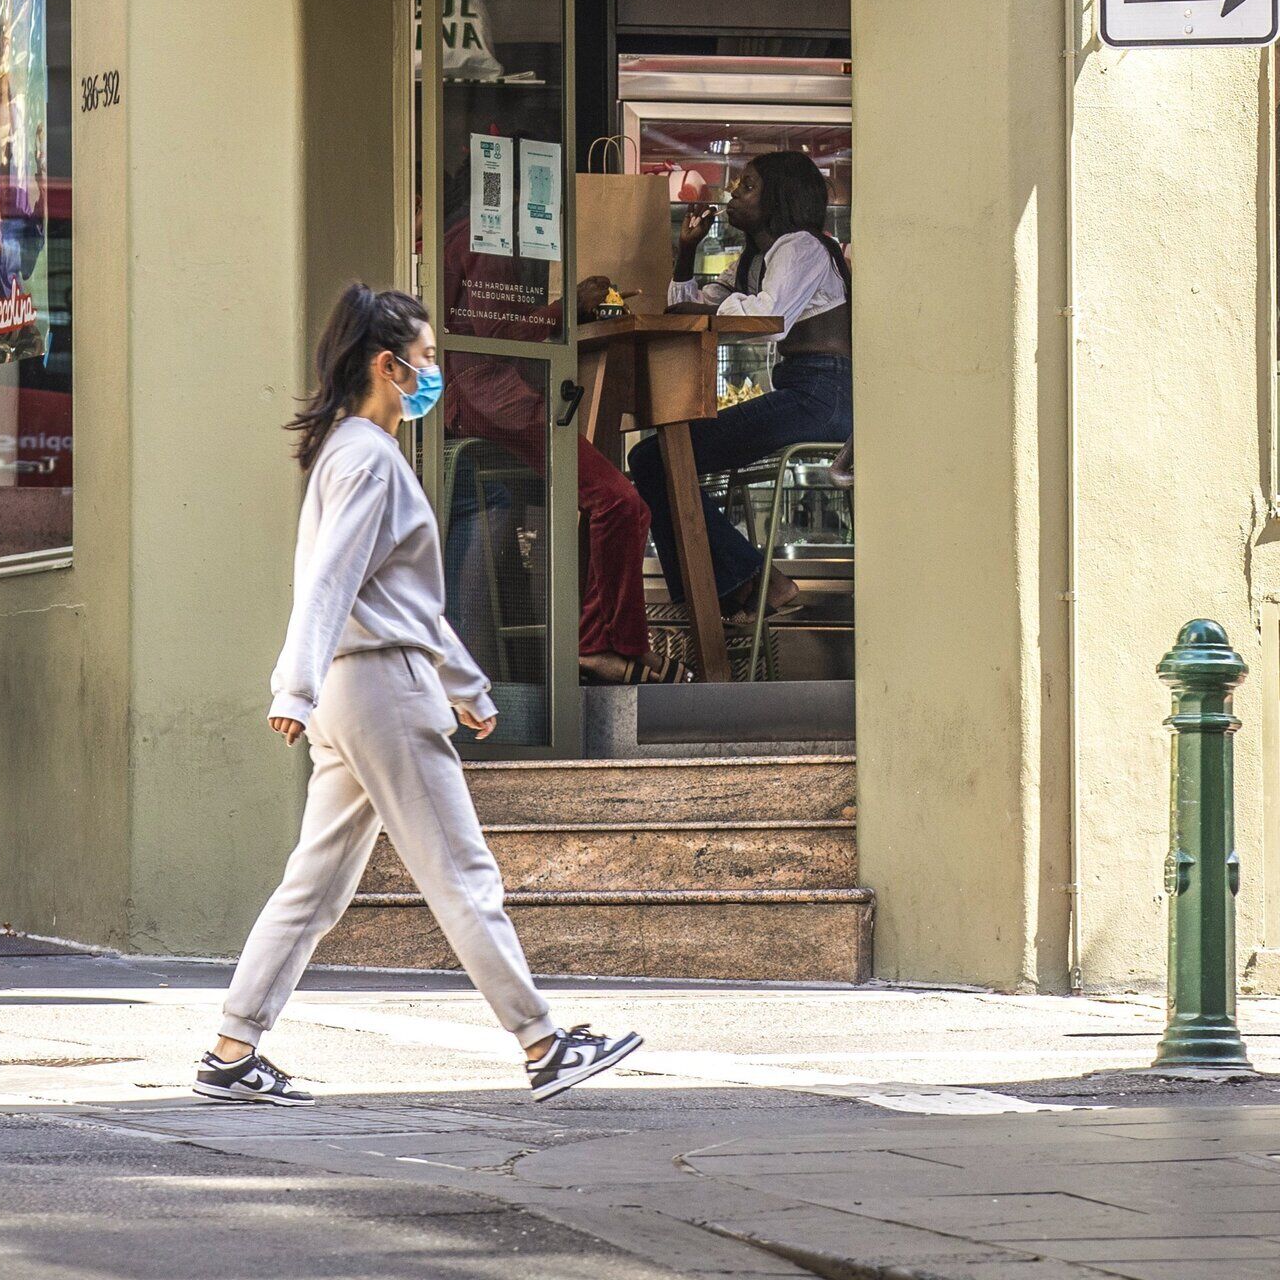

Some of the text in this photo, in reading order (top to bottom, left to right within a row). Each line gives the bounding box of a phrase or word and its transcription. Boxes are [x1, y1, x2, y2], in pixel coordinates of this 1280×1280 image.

[81, 70, 120, 113] 386-392
[461, 280, 545, 295] NO.43 HARDWARE LANE
[471, 290, 536, 304] MELBOURNE 3000
[449, 307, 557, 326] PICCOLINAGELATERIA.COM.AU
